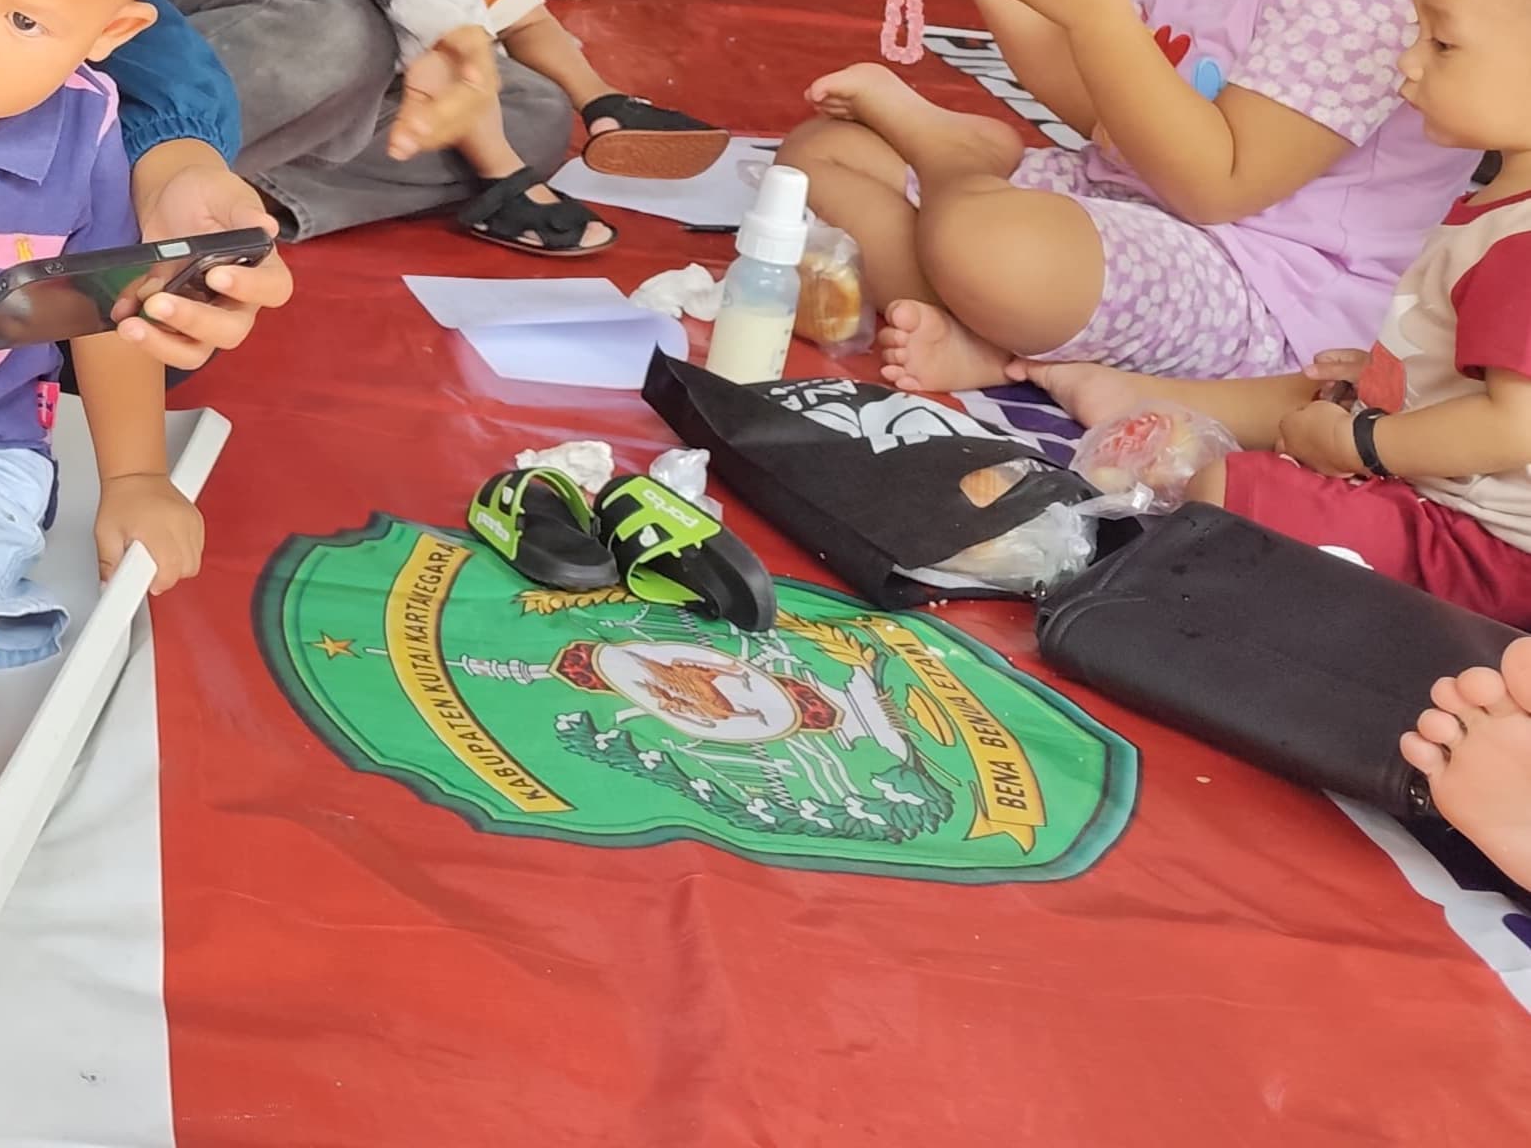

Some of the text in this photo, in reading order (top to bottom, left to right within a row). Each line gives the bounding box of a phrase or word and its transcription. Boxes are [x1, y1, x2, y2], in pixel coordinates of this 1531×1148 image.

[408, 645, 447, 693] KUTAI
[432, 698, 548, 800] KABUPATEN
[946, 696, 1009, 750] BENUA
[988, 760, 1028, 810] BENA
